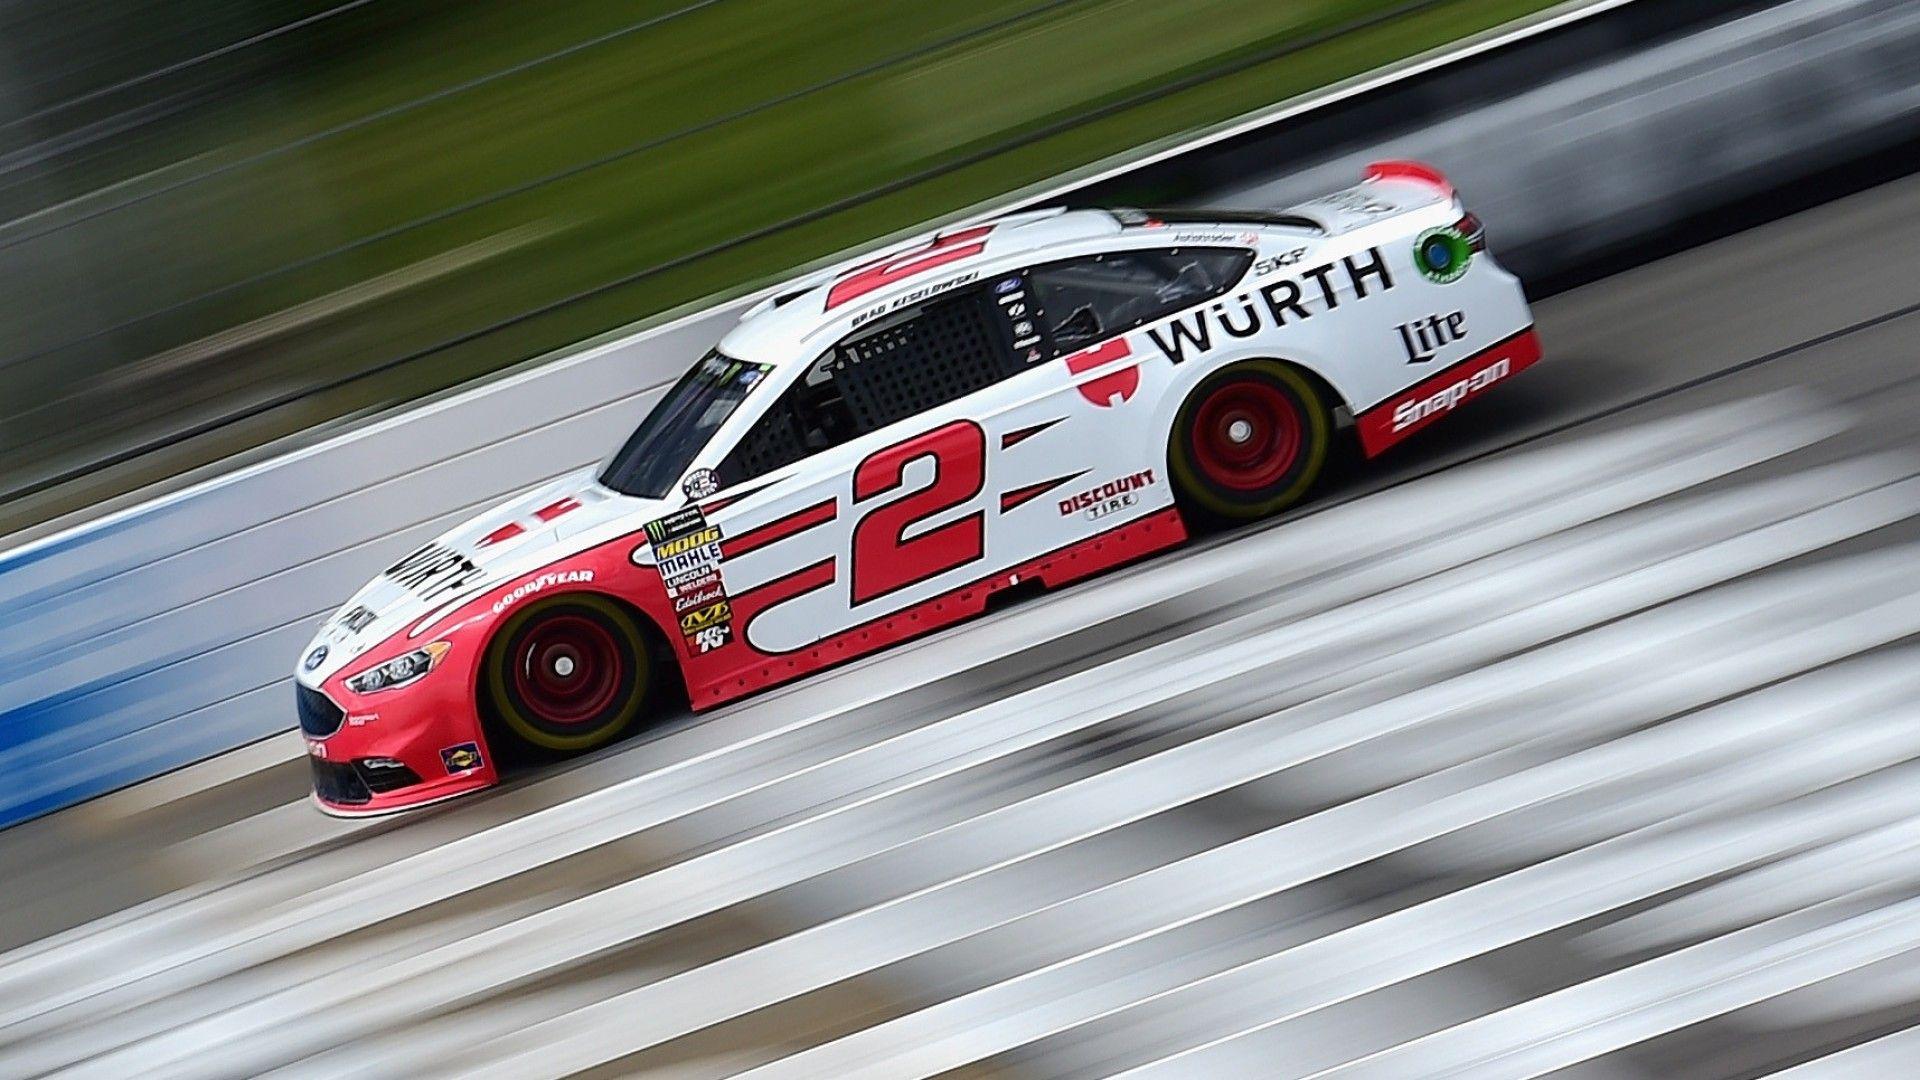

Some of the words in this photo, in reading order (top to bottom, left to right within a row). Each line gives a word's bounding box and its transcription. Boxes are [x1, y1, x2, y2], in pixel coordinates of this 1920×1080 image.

[1254, 246, 1308, 277] SKF
[1146, 246, 1394, 365] WÜRTH
[1394, 310, 1468, 364] Lite
[1058, 468, 1155, 516] DISCOUNT
[1088, 493, 1132, 518] TIRE
[849, 418, 987, 609] 2
[656, 527, 720, 560] MOOG
[659, 543, 721, 577] MAHLE
[492, 569, 596, 613] GOODYEAR
[667, 565, 711, 588] LINCOLN
